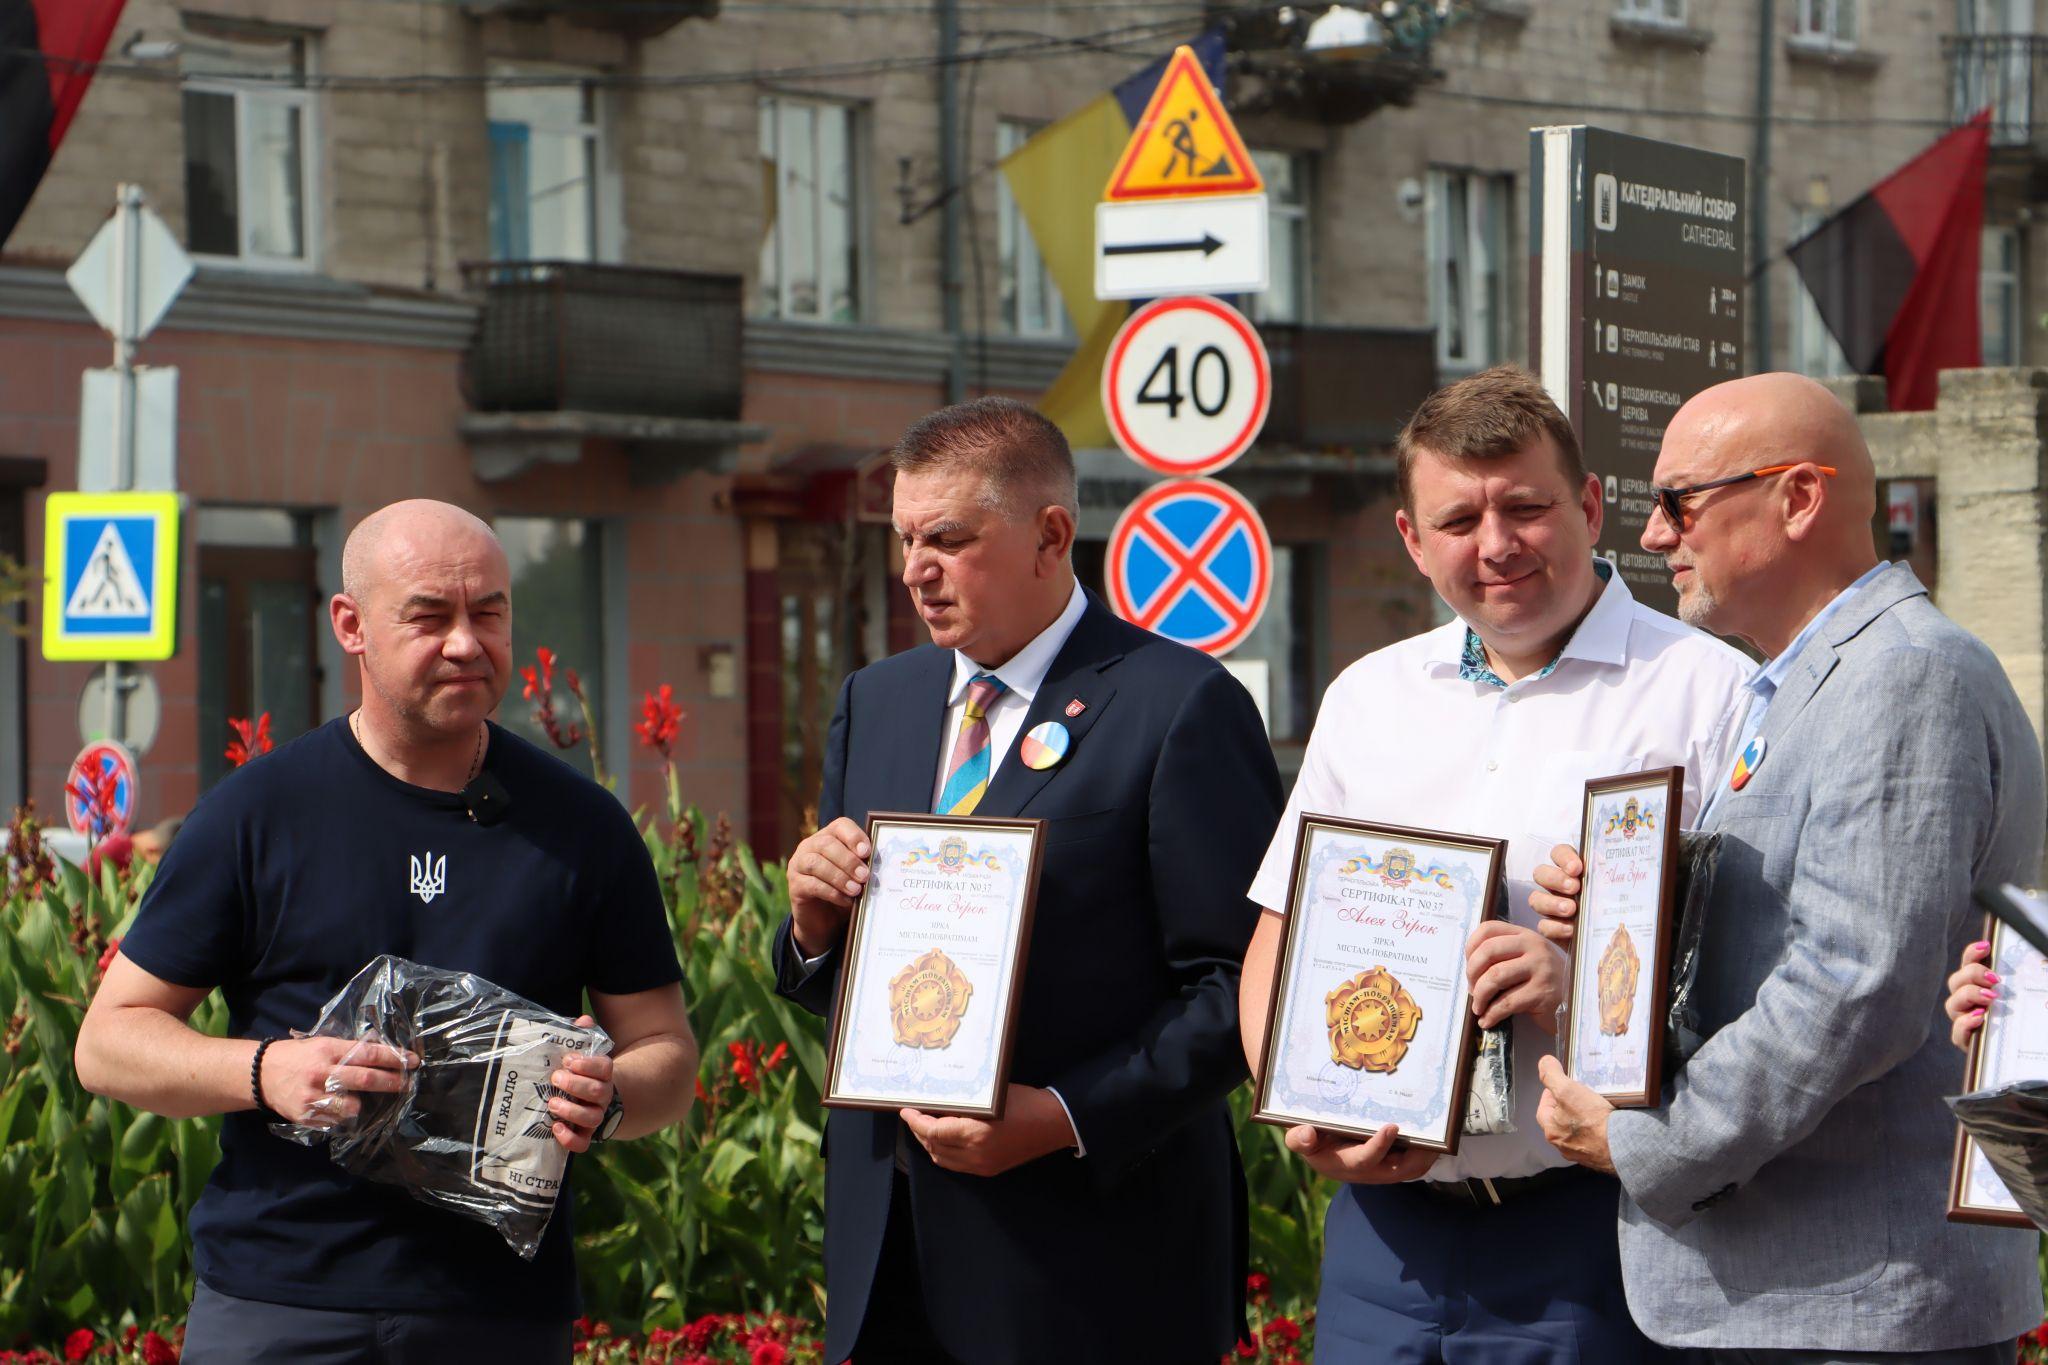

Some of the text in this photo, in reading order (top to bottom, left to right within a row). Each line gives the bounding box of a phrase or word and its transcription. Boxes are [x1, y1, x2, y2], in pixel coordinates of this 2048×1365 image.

[1621, 181, 1736, 221] КАТЕДРАЛЬНИЙ СОБОР
[1683, 223, 1736, 251] CATHEDRAL
[1622, 273, 1646, 289] ЗАМОК
[1622, 328, 1700, 352] ТЕРНОПІЛЬСЬКИЙ СТАВ
[1136, 345, 1231, 418] 40
[1622, 386, 1681, 406] ВОЗДВИЖЕНСЬКА
[1622, 406, 1648, 421] ЦЕРКВА
[1622, 479, 1648, 494] ЦЕРКВА
[1621, 554, 1665, 569] АВТОВОКЗАЛ
[902, 878, 968, 891] СЕРТИФІКАТ
[900, 893, 989, 919] Алея Зірок
[1341, 887, 1415, 908] СЕРТИФІКАТ
[1337, 905, 1386, 926] Алея
[1392, 908, 1439, 937] Зірок
[1373, 937, 1395, 947] ЗІРКА
[1336, 943, 1428, 965] МІСТАМ-ПОБРАТИМАМ
[495, 1070, 518, 1137] НІ ЖАЛЮ
[509, 1170, 560, 1190] НІ СТРА
